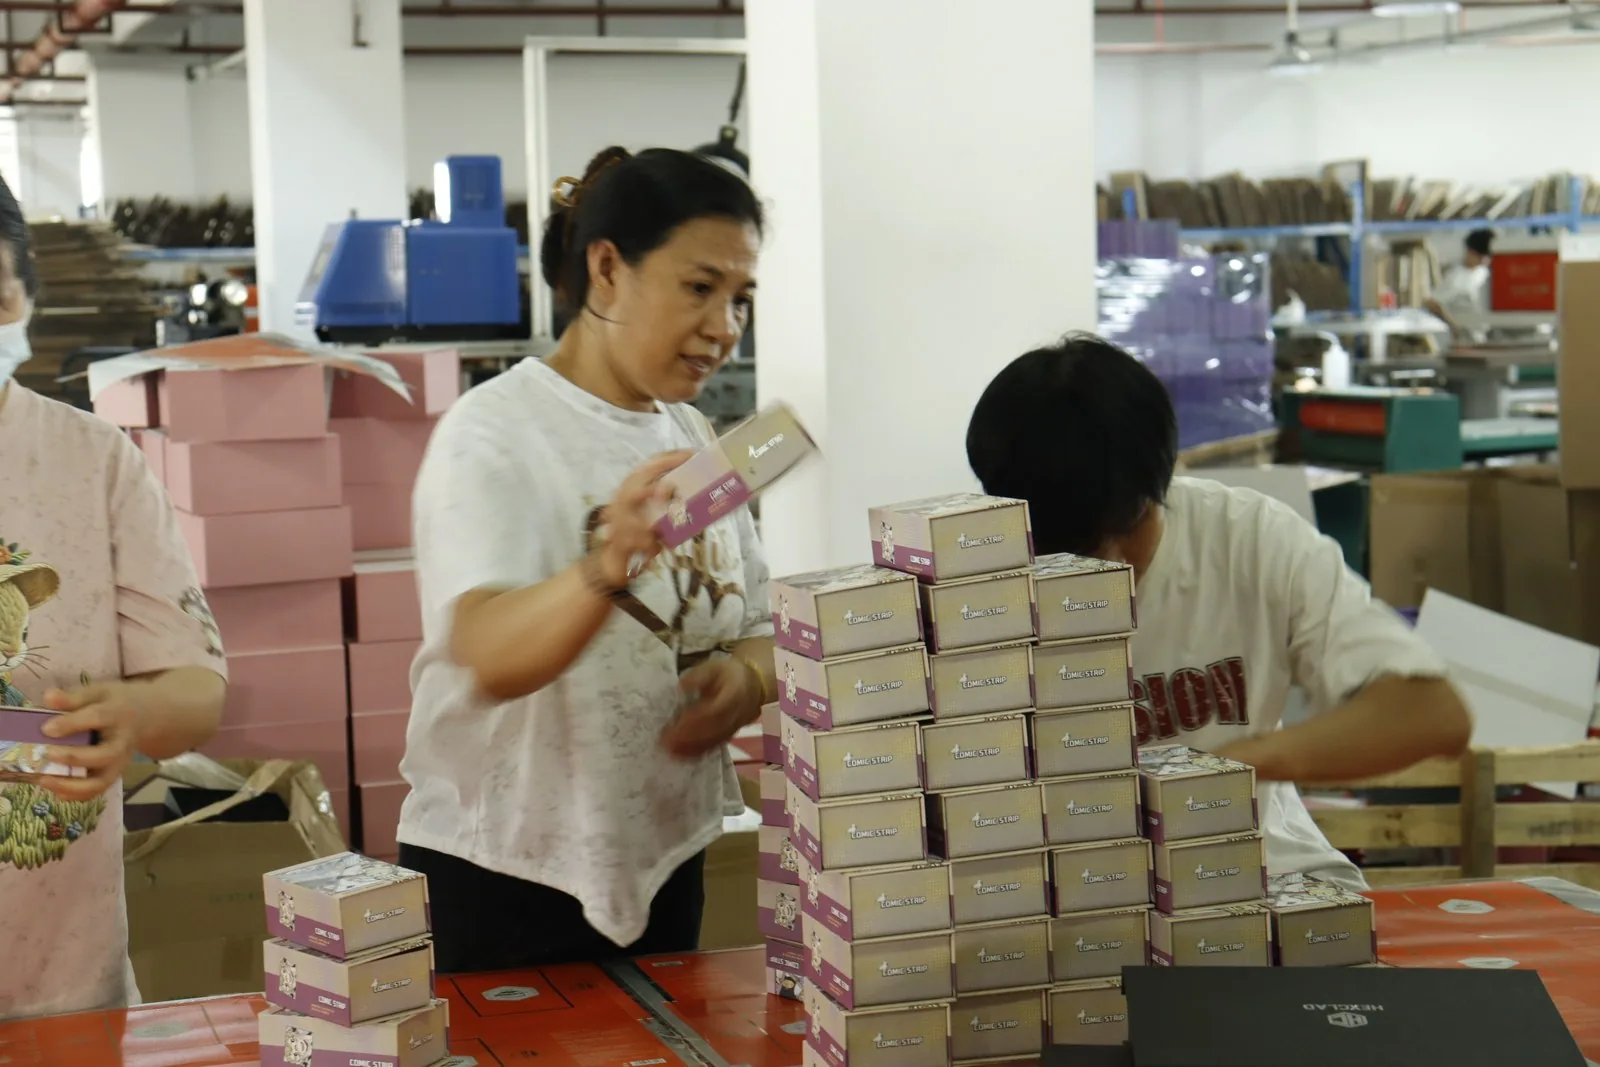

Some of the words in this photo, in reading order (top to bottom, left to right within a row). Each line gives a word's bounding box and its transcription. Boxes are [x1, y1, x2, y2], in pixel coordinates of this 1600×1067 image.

[961, 539, 982, 548] COMIC
[984, 535, 1004, 544] STRIP
[1065, 602, 1087, 611] COMIC
[1088, 600, 1108, 608] STRIP
[848, 616, 871, 625] COMIC
[872, 611, 893, 621] STRIP
[964, 610, 985, 620] COMIC
[987, 606, 1007, 616] STRIP
[1062, 671, 1084, 680] COMIC
[1085, 669, 1105, 678] STRIP
[858, 684, 880, 695] COMIC
[881, 680, 903, 691] STRIP
[962, 679, 985, 689] COMIC
[986, 676, 1007, 686] STRIP
[1065, 739, 1087, 748] COMIC
[1088, 736, 1108, 745] STRIP
[955, 751, 977, 760] COMIC
[978, 747, 1000, 757] STRIP
[847, 759, 870, 768] COMIC
[871, 756, 893, 765] STRIP
[1092, 804, 1112, 813] STRIP
[1189, 802, 1210, 811] COMIC
[1211, 799, 1231, 808] STRIP
[976, 819, 998, 827] COMIC
[999, 815, 1020, 824] STRIP
[852, 830, 874, 839] COMIC
[875, 828, 897, 837] STRIP
[1085, 875, 1106, 884] COMIC
[1107, 872, 1127, 881] STRIP
[1197, 871, 1219, 880] COMIC
[1220, 867, 1240, 877] STRIP
[977, 886, 999, 895] COMIC
[1000, 882, 1020, 892] STRIP
[881, 900, 903, 909] COMIC
[905, 897, 926, 905] STRIP
[1308, 936, 1328, 944] COMIC
[1330, 932, 1349, 941] STRIP
[1078, 943, 1100, 952] COMIC
[1102, 941, 1122, 949] STRIP
[1200, 945, 1222, 954] COMIC
[1224, 943, 1244, 951] STRIP
[981, 954, 1002, 963] COMIC
[1004, 951, 1025, 961] STRIP
[882, 968, 905, 977] COMIC
[907, 965, 927, 974] STRIP
[1302, 1003, 1384, 1011] HEXCLAD
[1080, 1016, 1103, 1025] COMIC
[1104, 1014, 1125, 1023] STRIP
[973, 1023, 996, 1032] COMIC
[998, 1020, 1018, 1029] STRIP
[877, 1040, 900, 1048] COMIC
[901, 1037, 923, 1045] STRIP
[350, 1059, 368, 1067] COMIC
